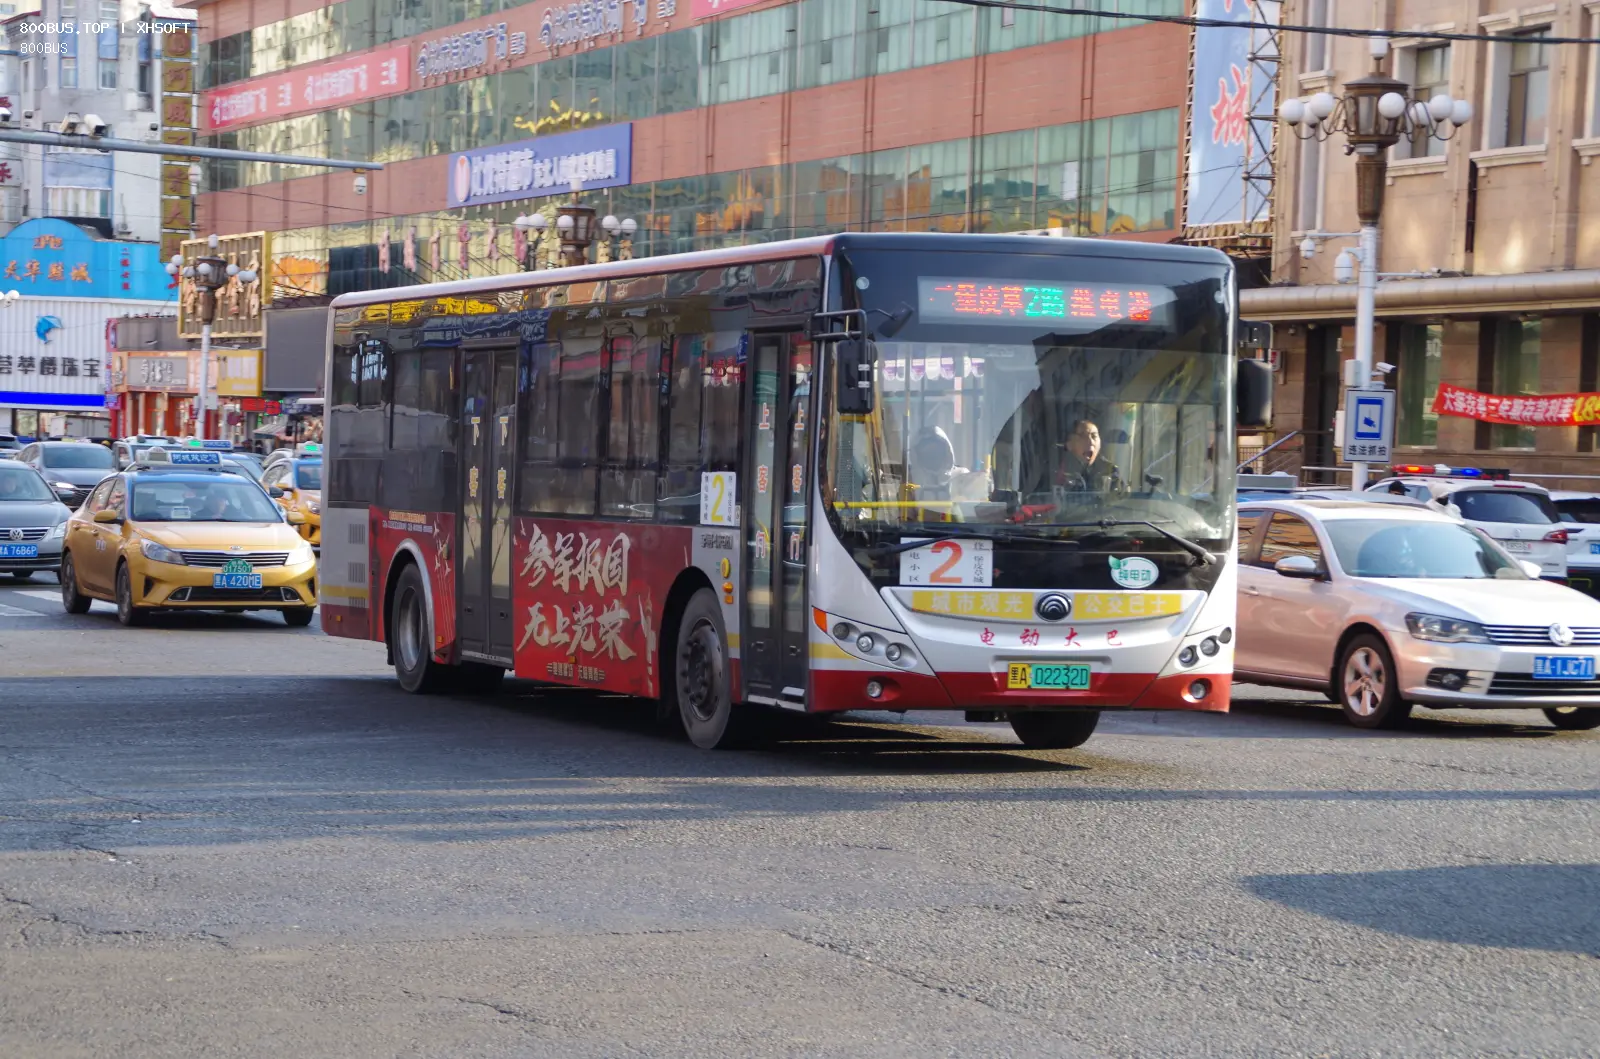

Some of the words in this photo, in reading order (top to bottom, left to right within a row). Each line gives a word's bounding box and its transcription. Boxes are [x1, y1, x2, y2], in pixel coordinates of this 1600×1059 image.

[711, 474, 726, 522] 2
[520, 523, 631, 596] 参军报国
[929, 541, 963, 584] 2
[931, 591, 1024, 614] 城市观光
[1084, 591, 1168, 614] 公交巴士
[516, 599, 637, 661] 无上光荣
[979, 627, 1122, 647] 电动大巴
